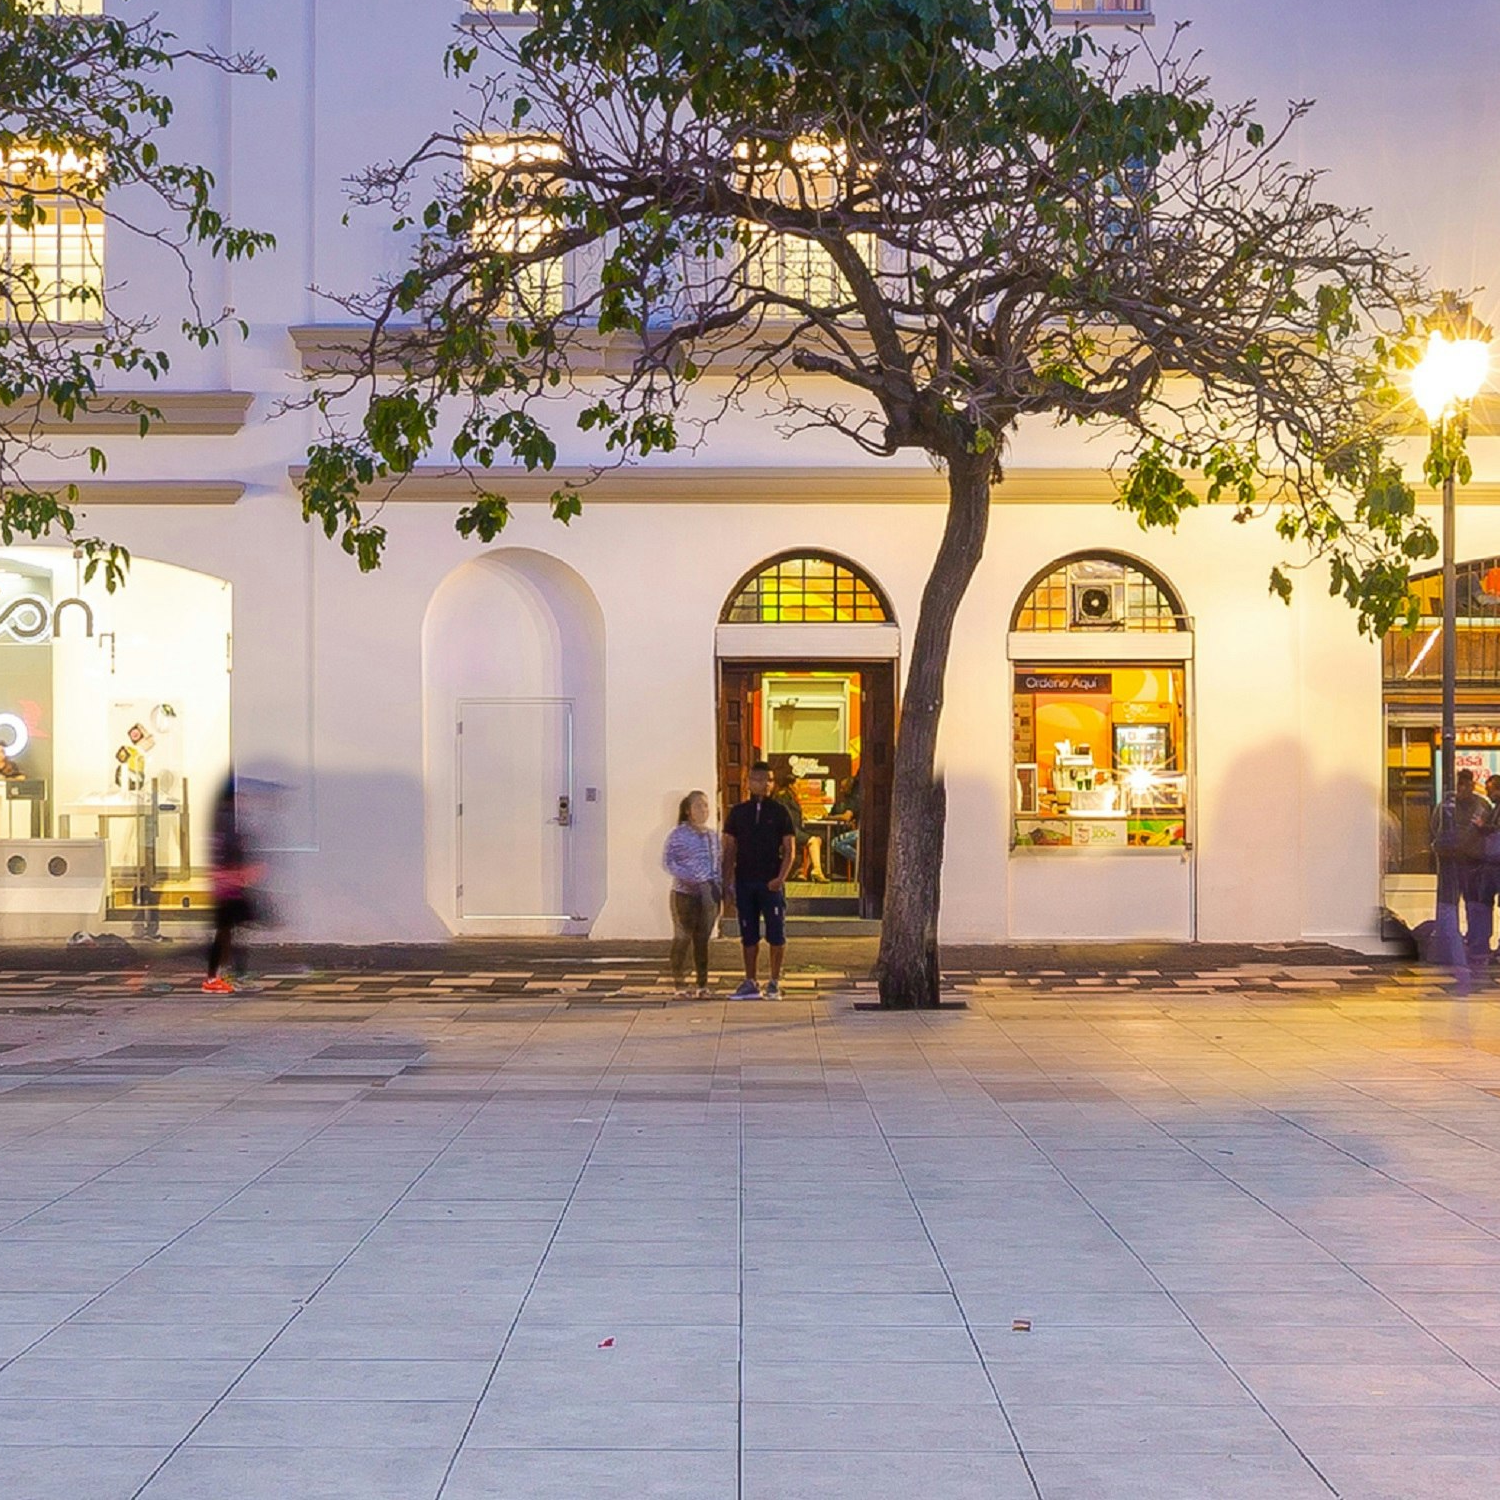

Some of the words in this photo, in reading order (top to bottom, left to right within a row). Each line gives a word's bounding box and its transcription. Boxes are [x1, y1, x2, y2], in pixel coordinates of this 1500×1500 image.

[1025, 676, 1069, 689] Ordene
[1070, 676, 1098, 691] Aquí
[1456, 751, 1483, 767] asá
